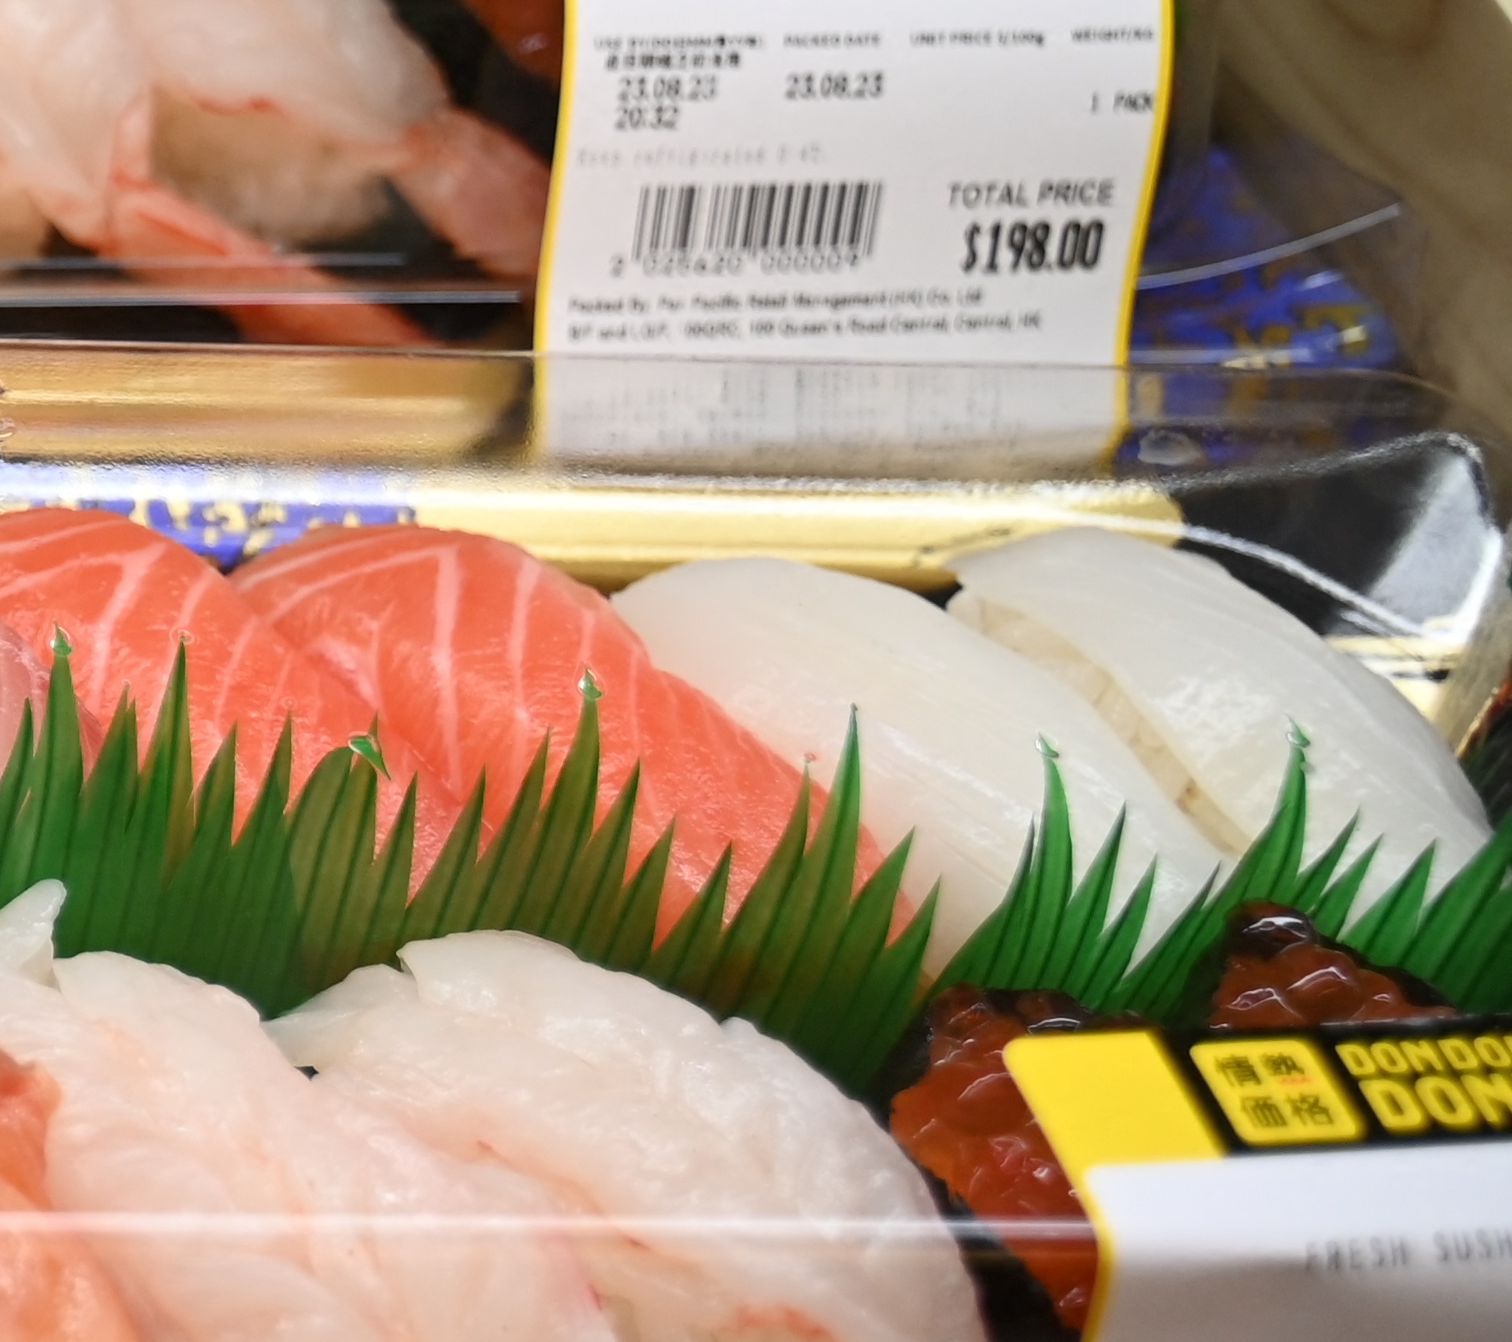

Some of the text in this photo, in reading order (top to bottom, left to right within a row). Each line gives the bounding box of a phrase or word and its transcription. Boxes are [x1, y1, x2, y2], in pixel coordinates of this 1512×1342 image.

[948, 178, 1115, 209] TOTAL PRICE
[961, 218, 1105, 275] $198.00
[1305, 1235, 1408, 1271] FRESH
